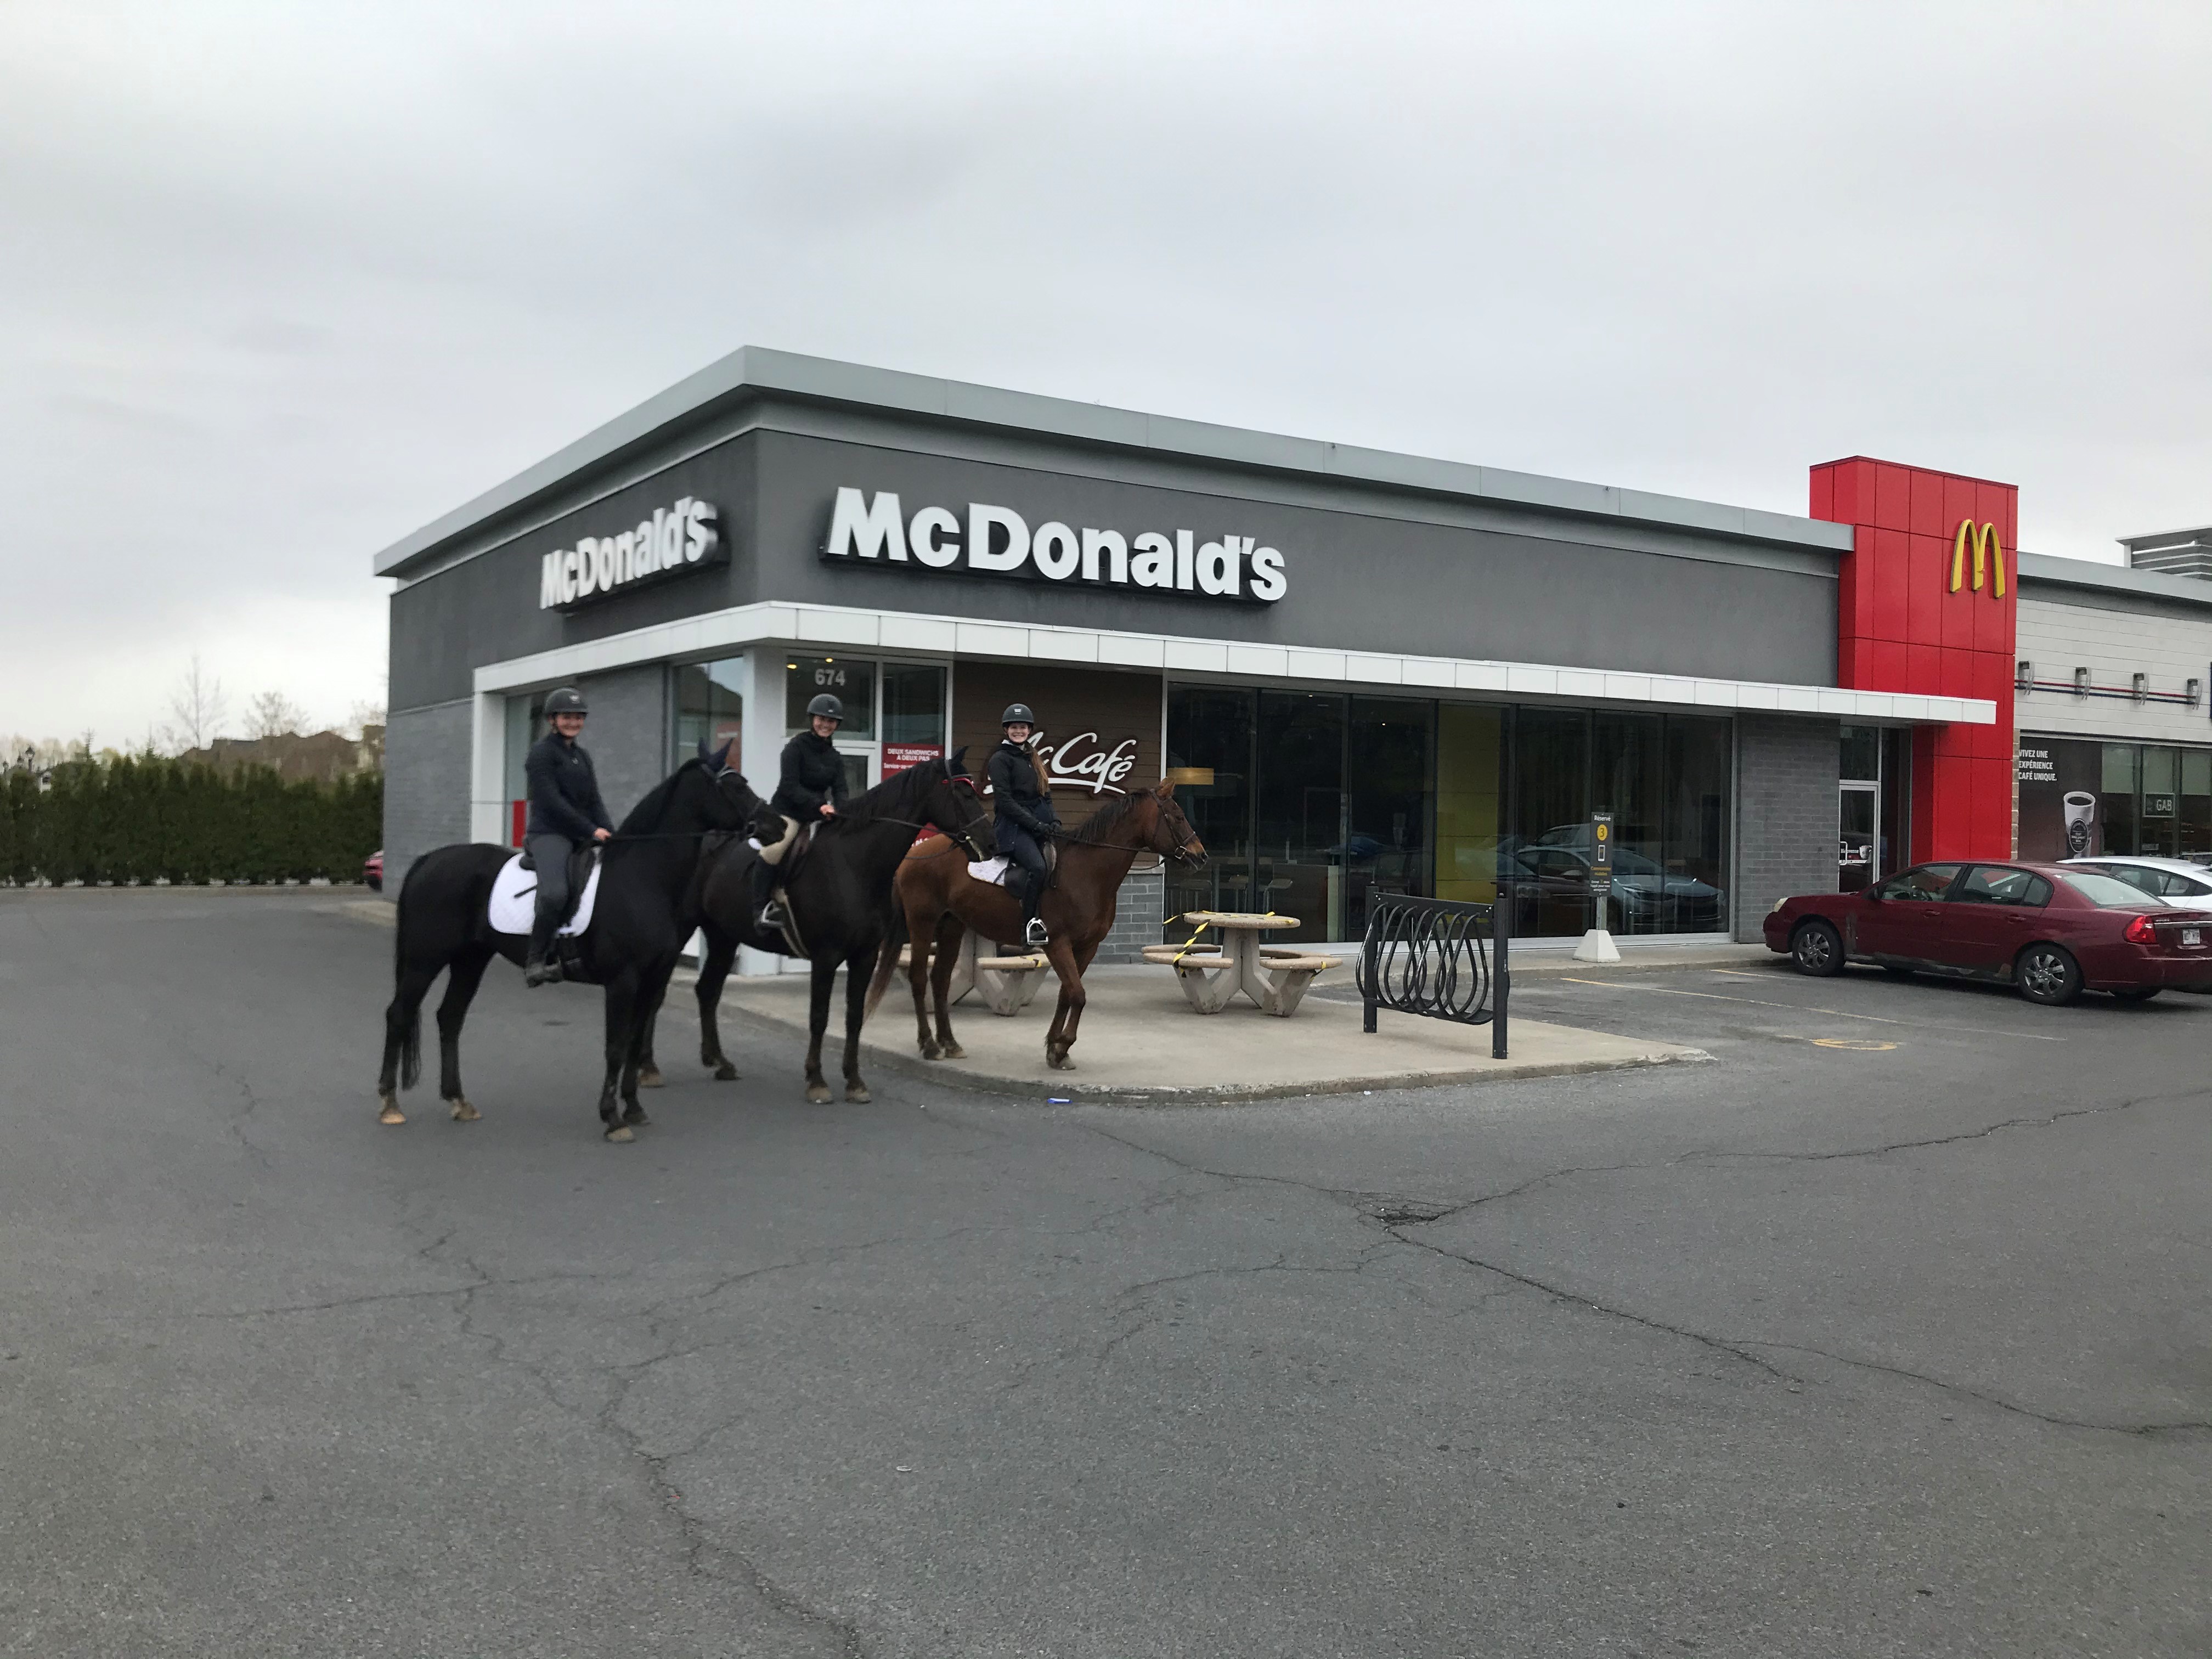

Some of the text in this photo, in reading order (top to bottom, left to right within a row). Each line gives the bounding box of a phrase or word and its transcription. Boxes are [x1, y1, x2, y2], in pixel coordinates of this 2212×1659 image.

[826, 487, 1288, 601] McDonald's
[540, 495, 717, 610] McDonald's
[815, 669, 845, 686] 674
[2019, 749, 2035, 758] VIVEZ
[2019, 759, 2053, 770] EXPÉRIENCE
[2019, 771, 2057, 781] CAFÉ UNIQUE.
[2156, 799, 2172, 811] GAB
[1600, 828, 1605, 837] 3
